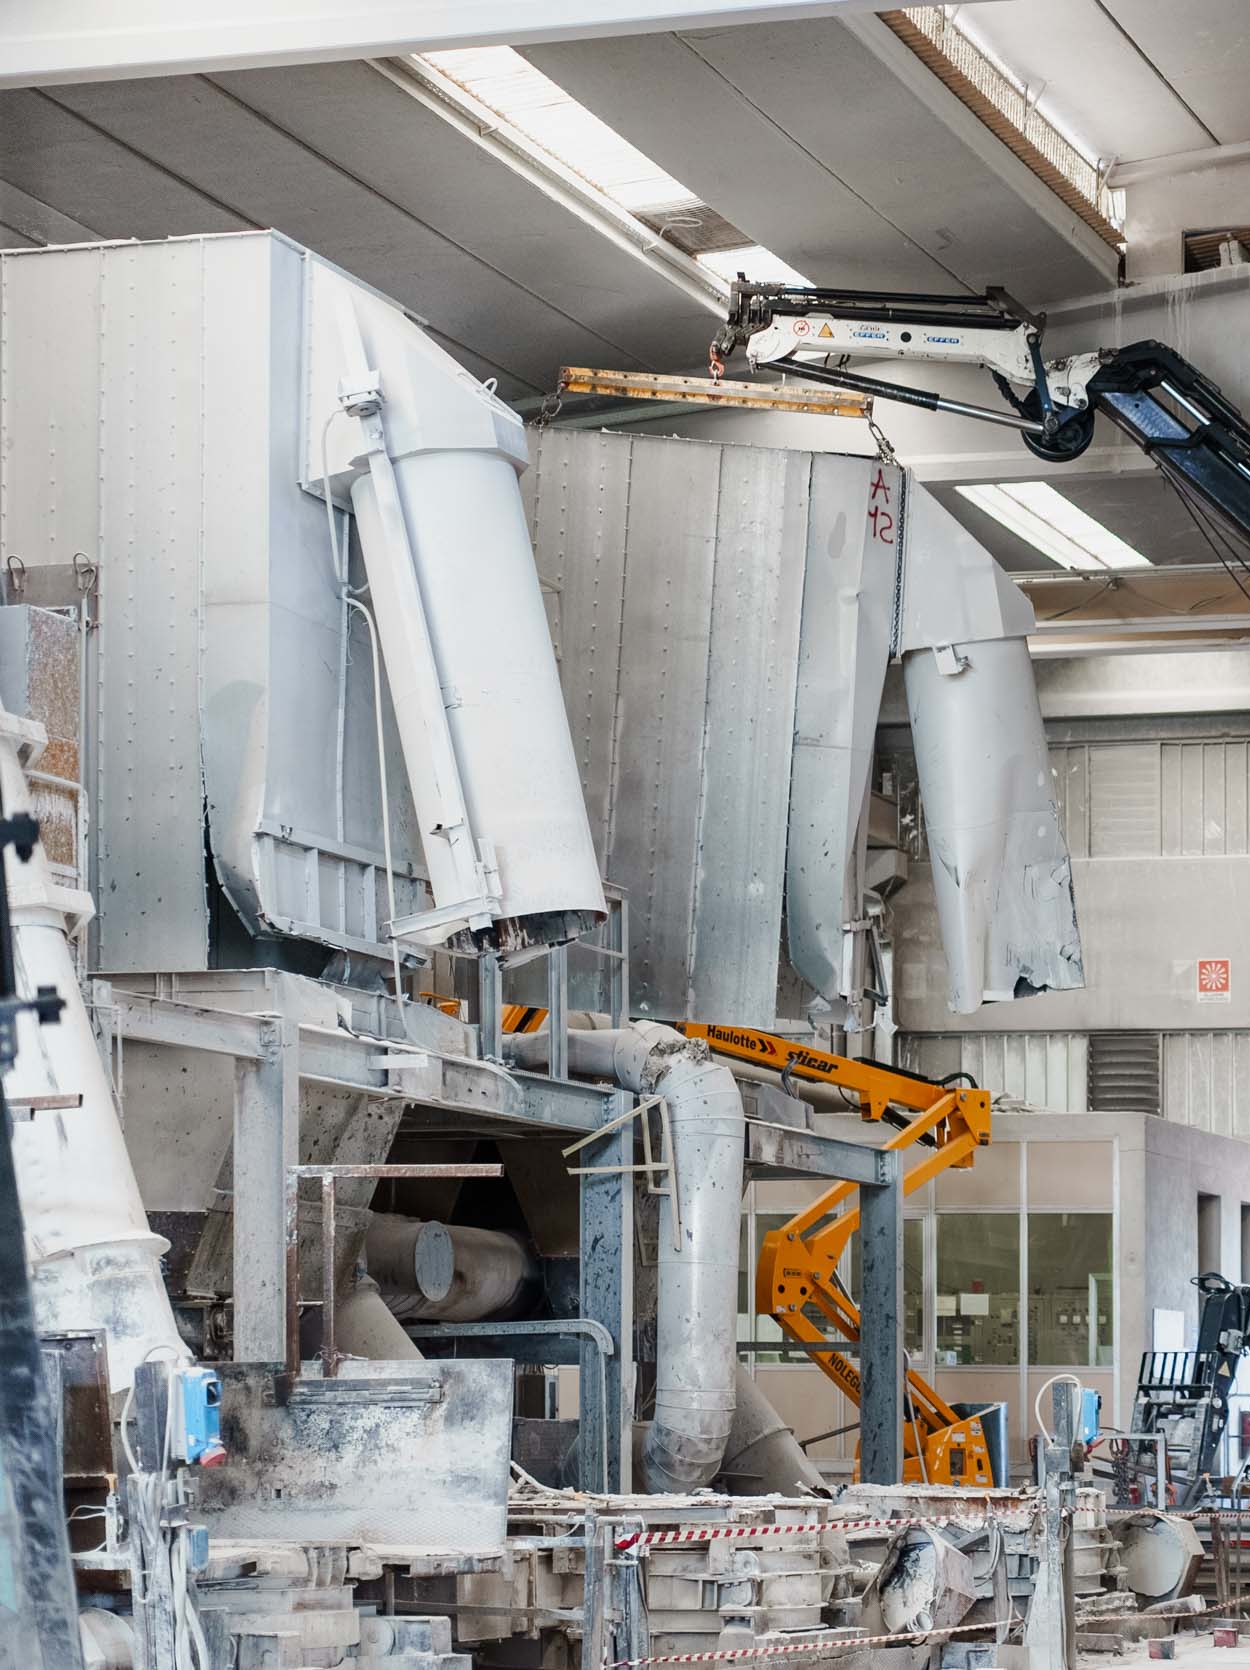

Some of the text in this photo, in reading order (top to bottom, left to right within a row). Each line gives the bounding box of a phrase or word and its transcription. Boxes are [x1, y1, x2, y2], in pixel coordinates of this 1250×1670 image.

[926, 336, 960, 344] EFFER
[871, 468, 891, 504] A
[868, 505, 893, 544] 12
[707, 1024, 757, 1050] Haulotte
